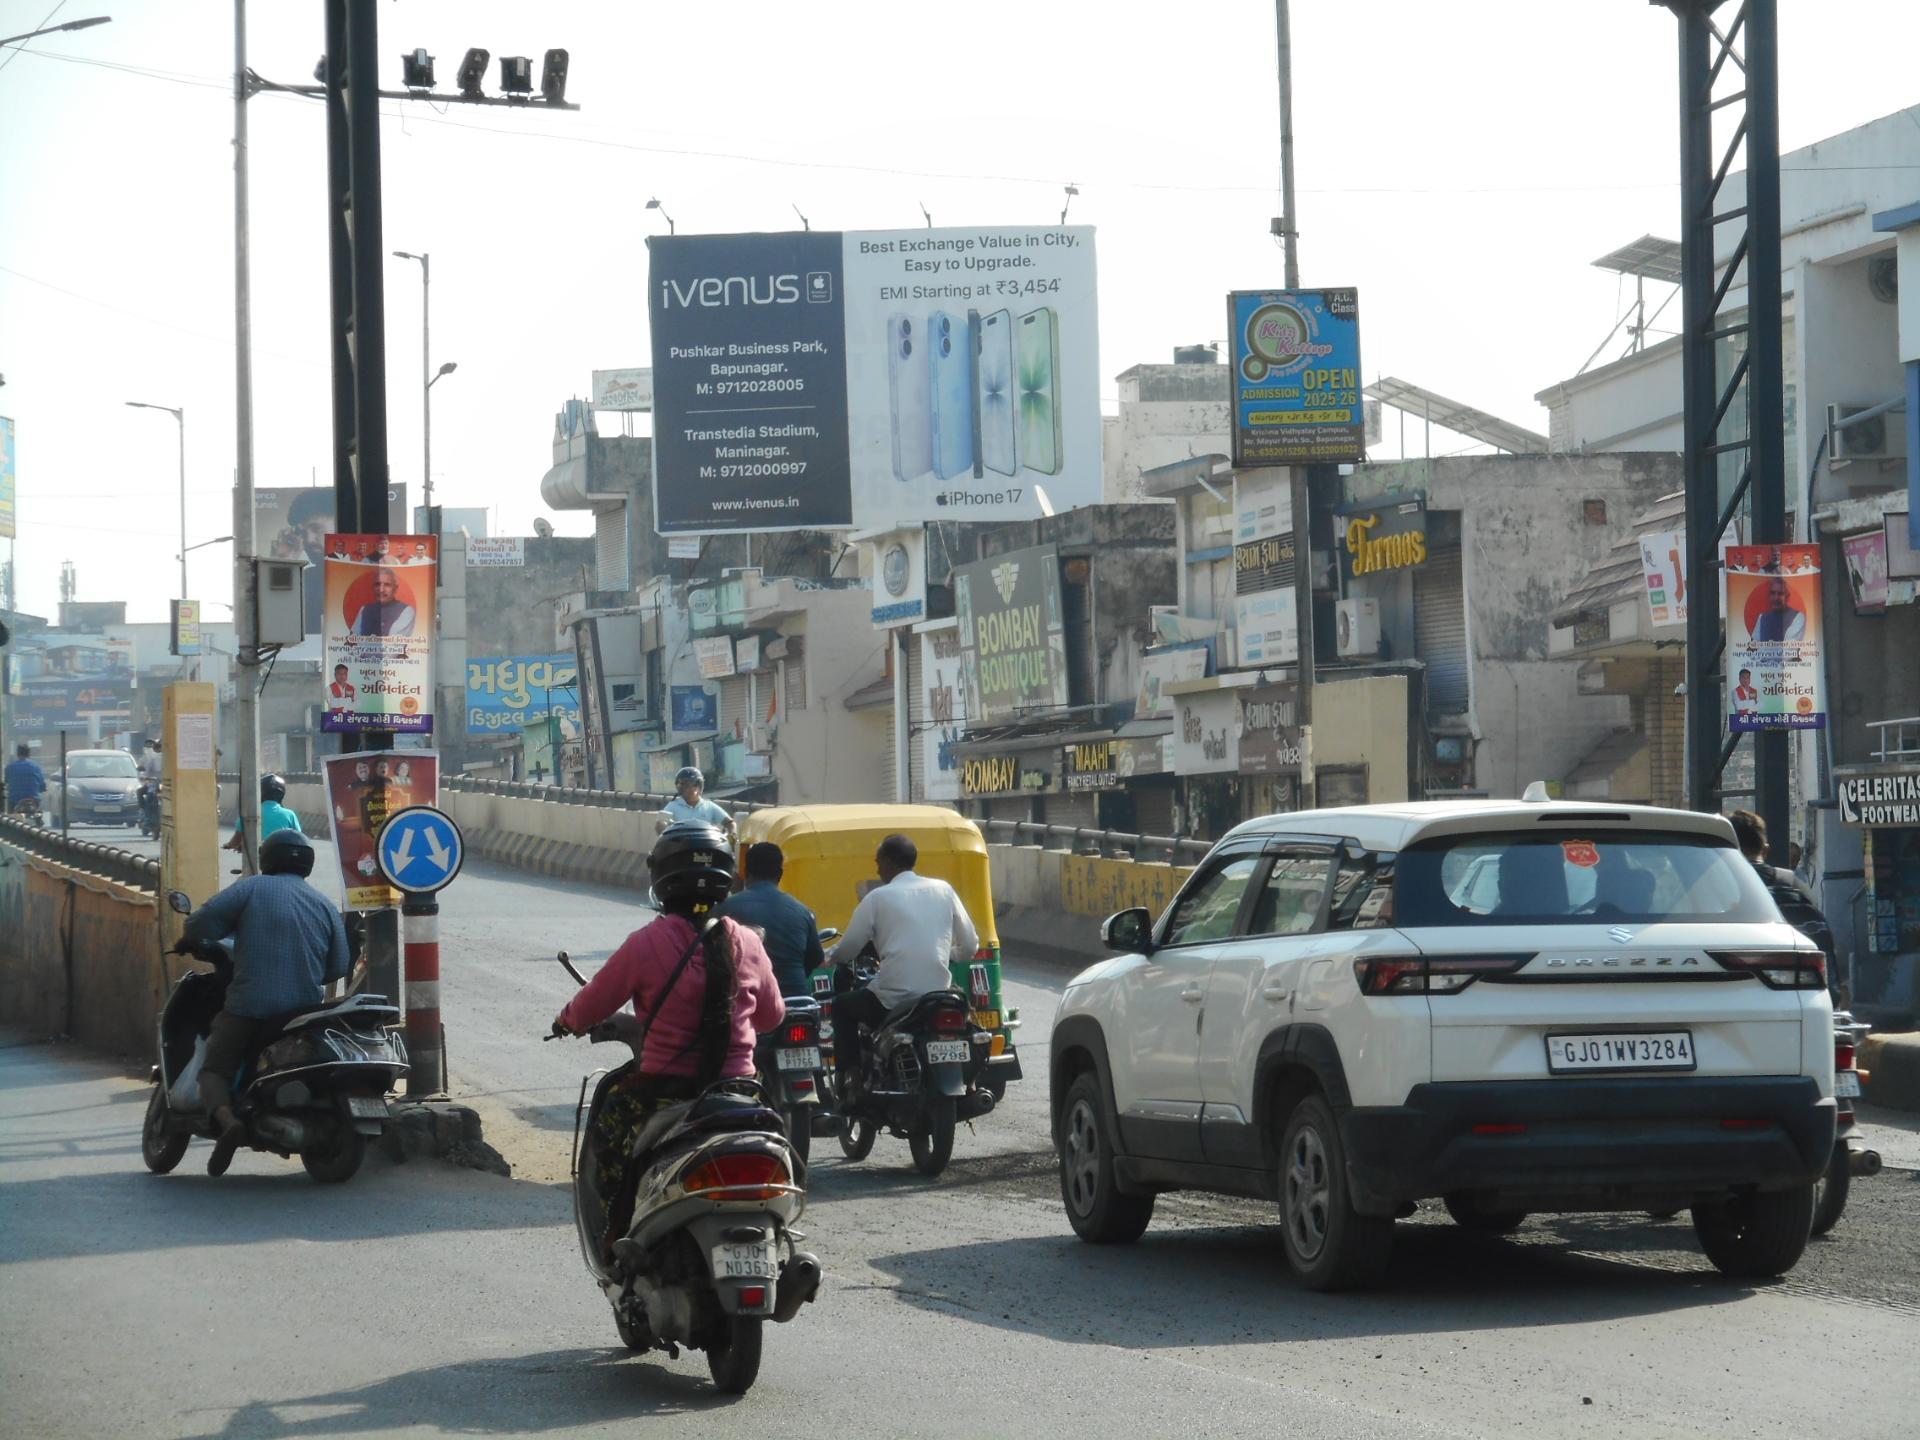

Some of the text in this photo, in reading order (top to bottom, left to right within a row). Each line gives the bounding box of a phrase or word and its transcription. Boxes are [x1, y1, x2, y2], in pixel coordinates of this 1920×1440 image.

[860, 233, 1080, 253] Best Exchange Value in City,
[905, 255, 1036, 273] Easy to Upgrade.
[880, 287, 907, 300] EMI
[912, 284, 972, 299] Starting
[977, 284, 991, 295] at
[1331, 303, 1356, 313] Class
[670, 340, 827, 358] Pushkar Business Park,
[711, 363, 788, 377] Bapunagar.
[696, 379, 804, 395] M: 9712028005
[1304, 369, 1356, 390] OPEN
[1242, 388, 1299, 400] ADMISSION
[684, 424, 819, 441] Transtedia Stadium,
[716, 445, 790, 459] Maninagar.
[700, 462, 807, 478] M: 9712000997
[712, 496, 799, 510] www.ivenus.in
[949, 488, 1023, 507] iPhone 17
[977, 604, 1040, 656] BOMBAY
[980, 649, 1048, 695] BOUTIQUE
[360, 680, 421, 695] અભિનંદન
[1762, 683, 1814, 696] અભિનંદન
[332, 713, 344, 724] શ્રી
[347, 713, 370, 724] સંજય
[1739, 714, 1749, 724] શ્રી
[1075, 743, 1109, 772] MAAHI
[964, 757, 1015, 792] BOMBAY
[1099, 772, 1117, 786] OUTLET
[1861, 804, 1920, 824] FOOTWEA
[1547, 957, 1699, 967] BREZZA
[930, 1051, 967, 1062] 5798
[1564, 1039, 1688, 1063] GJ01WV3284
